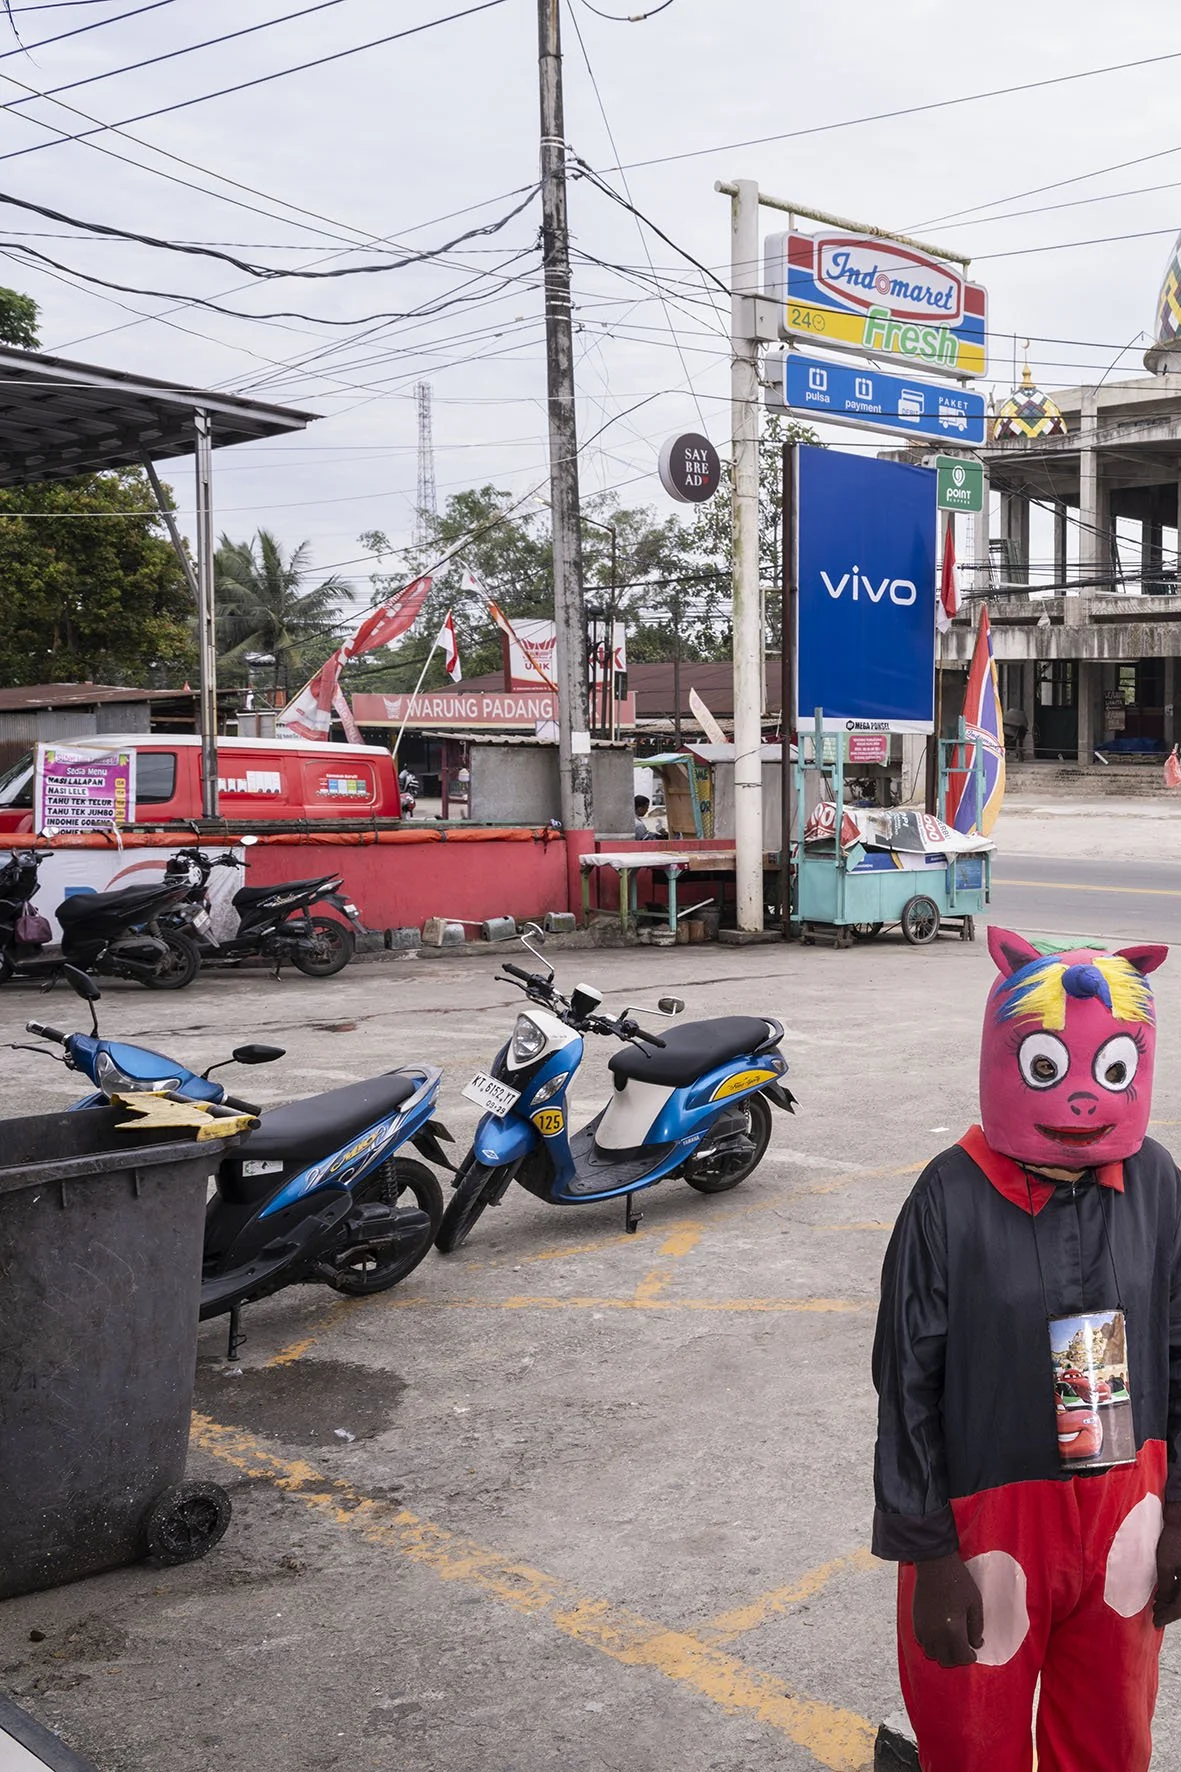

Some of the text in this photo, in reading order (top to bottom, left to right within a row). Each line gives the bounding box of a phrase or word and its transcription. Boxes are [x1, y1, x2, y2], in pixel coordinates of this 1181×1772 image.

[826, 252, 954, 310] Indomaret
[791, 309, 811, 327] 24
[864, 305, 960, 368] Fresh
[805, 391, 831, 404] pulsa
[939, 397, 968, 410] PAKET
[845, 399, 882, 414] payment
[684, 448, 708, 461] SAY
[685, 461, 709, 474] BRE
[685, 474, 703, 486] AD
[820, 565, 917, 606] vivo
[406, 699, 552, 718] WARUNG PADANG
[855, 722, 870, 731] MEGA
[87, 768, 107, 776] Menu
[68, 777, 104, 786] LALAPAN
[48, 797, 69, 805] TAHU
[47, 807, 69, 815] TAHU
[47, 818, 79, 826] INDOMIE
[472, 1075, 516, 1105] KT 6152 YT
[539, 1115, 560, 1130] 125
